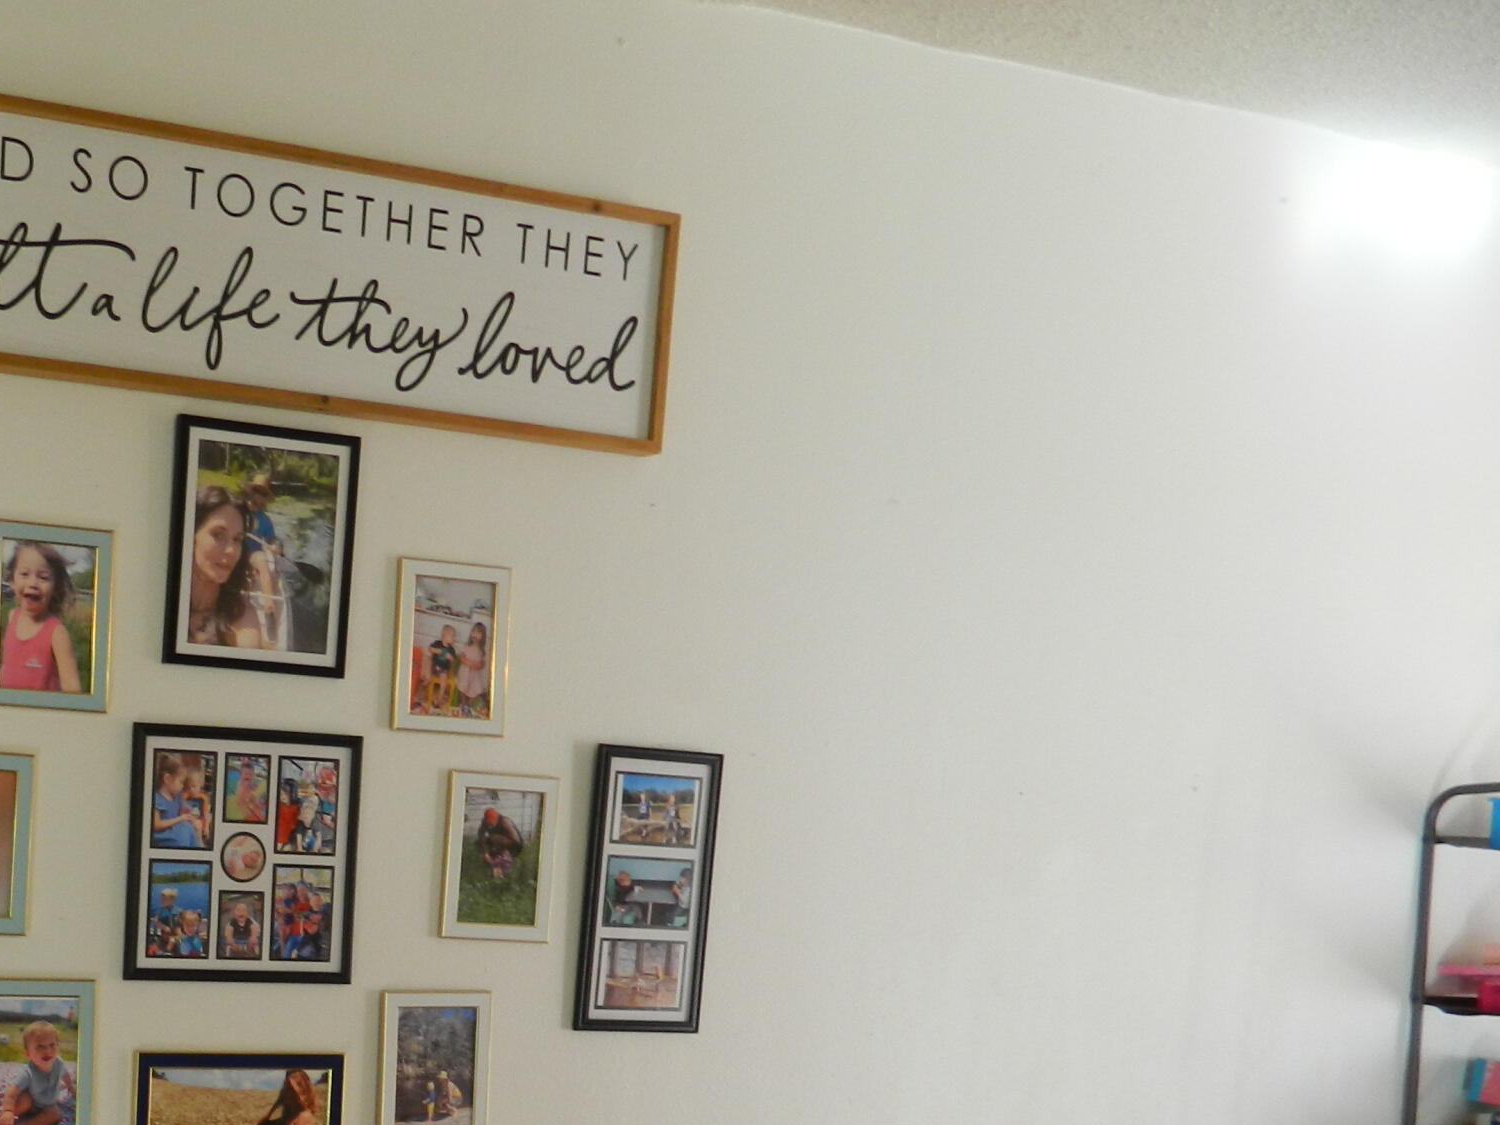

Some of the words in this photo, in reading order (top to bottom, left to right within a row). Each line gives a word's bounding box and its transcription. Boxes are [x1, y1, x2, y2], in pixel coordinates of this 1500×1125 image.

[70, 147, 148, 200] SO
[184, 165, 485, 258] TOGETHER
[516, 222, 639, 281] THEY
[91, 293, 121, 321] a
[141, 245, 281, 370] life
[289, 277, 469, 392] they
[458, 291, 639, 392] loved
